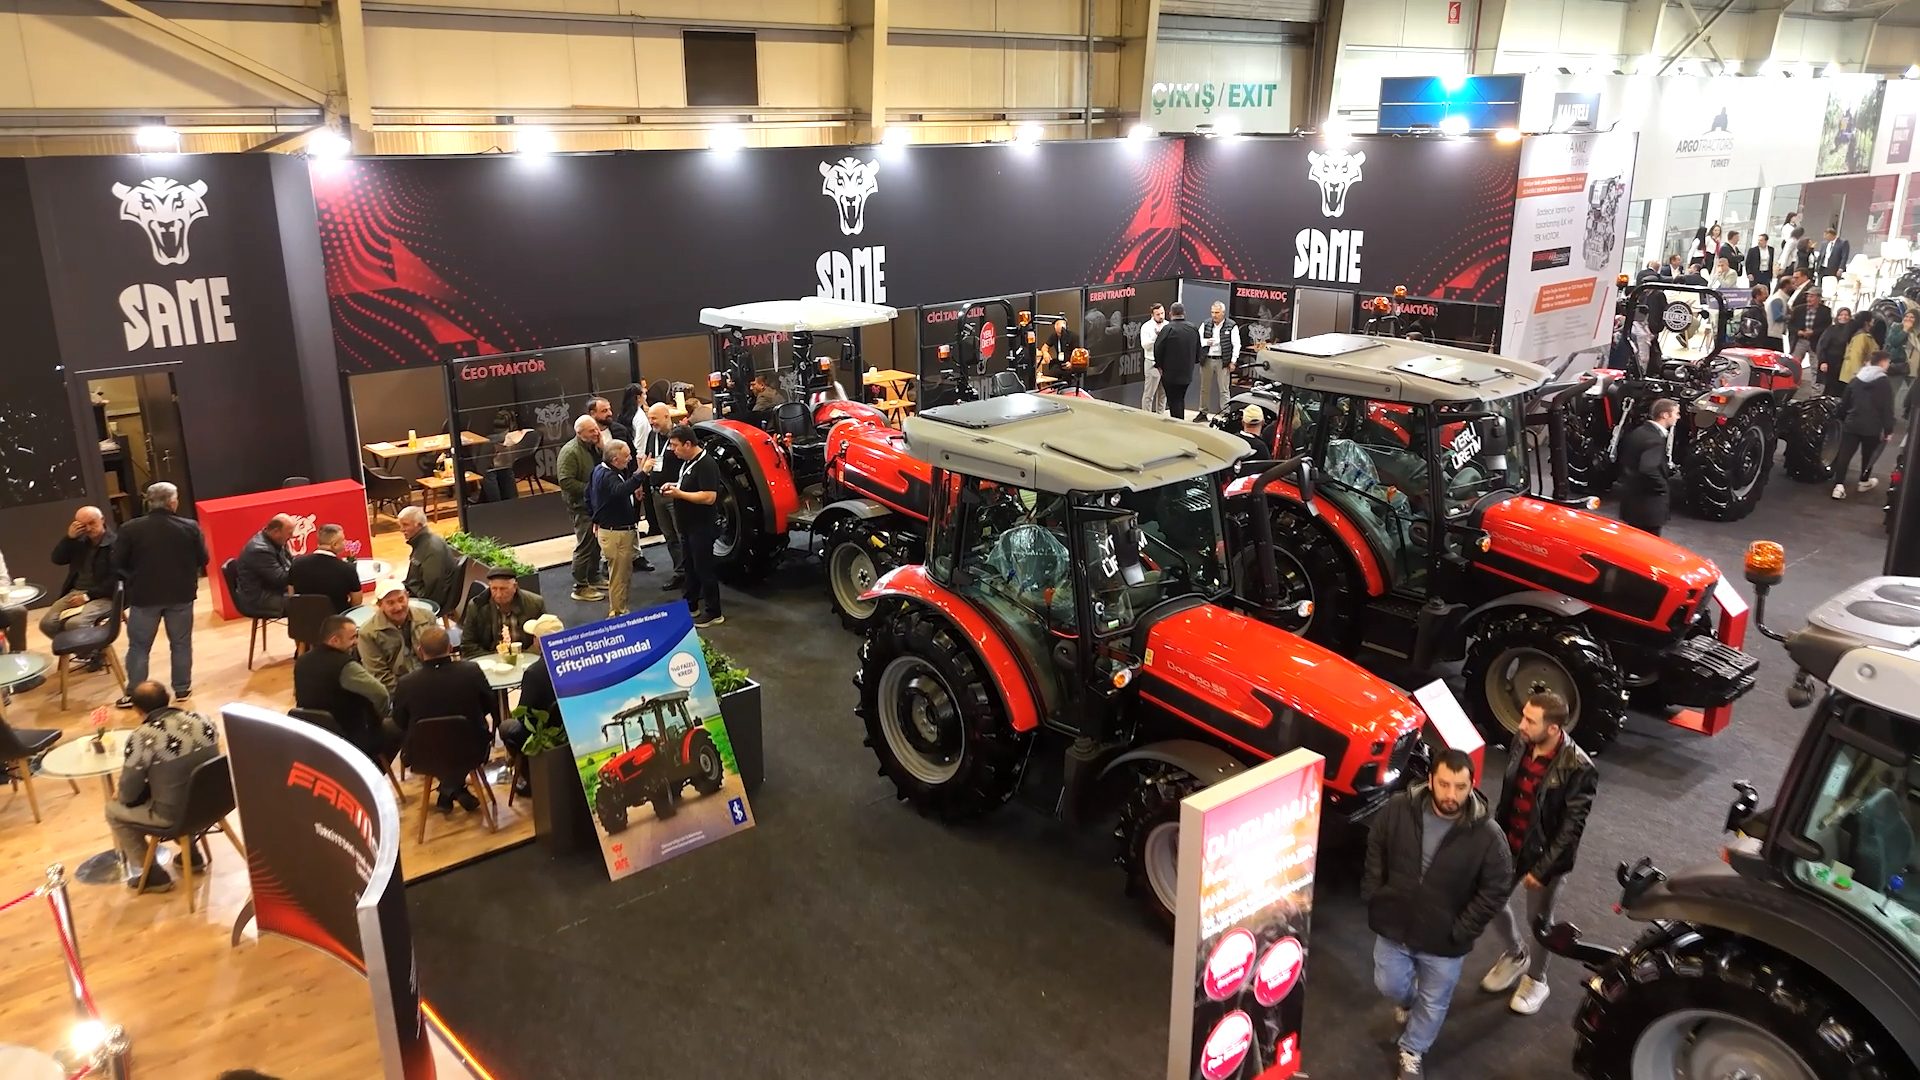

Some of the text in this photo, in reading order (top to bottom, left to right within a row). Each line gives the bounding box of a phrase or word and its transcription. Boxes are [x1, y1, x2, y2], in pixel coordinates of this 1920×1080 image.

[1293, 228, 1364, 284] SAME
[816, 245, 887, 304] SAME
[1089, 287, 1136, 302] EREN TRAKTÖR
[1236, 287, 1288, 303] ZEKERYA KOÇ
[119, 277, 237, 352] SAME
[927, 309, 943, 324] CİCİ
[745, 330, 790, 346] TRAKTÖR
[490, 359, 546, 377] TRAKTÖR
[1119, 352, 1142, 377] SAME
[547, 638, 563, 647] Same
[626, 618, 644, 627] Traktör
[551, 634, 625, 661] Benim Bankam
[555, 639, 652, 677] çiftçinin yanında!
[1166, 660, 1211, 688] Dorado
